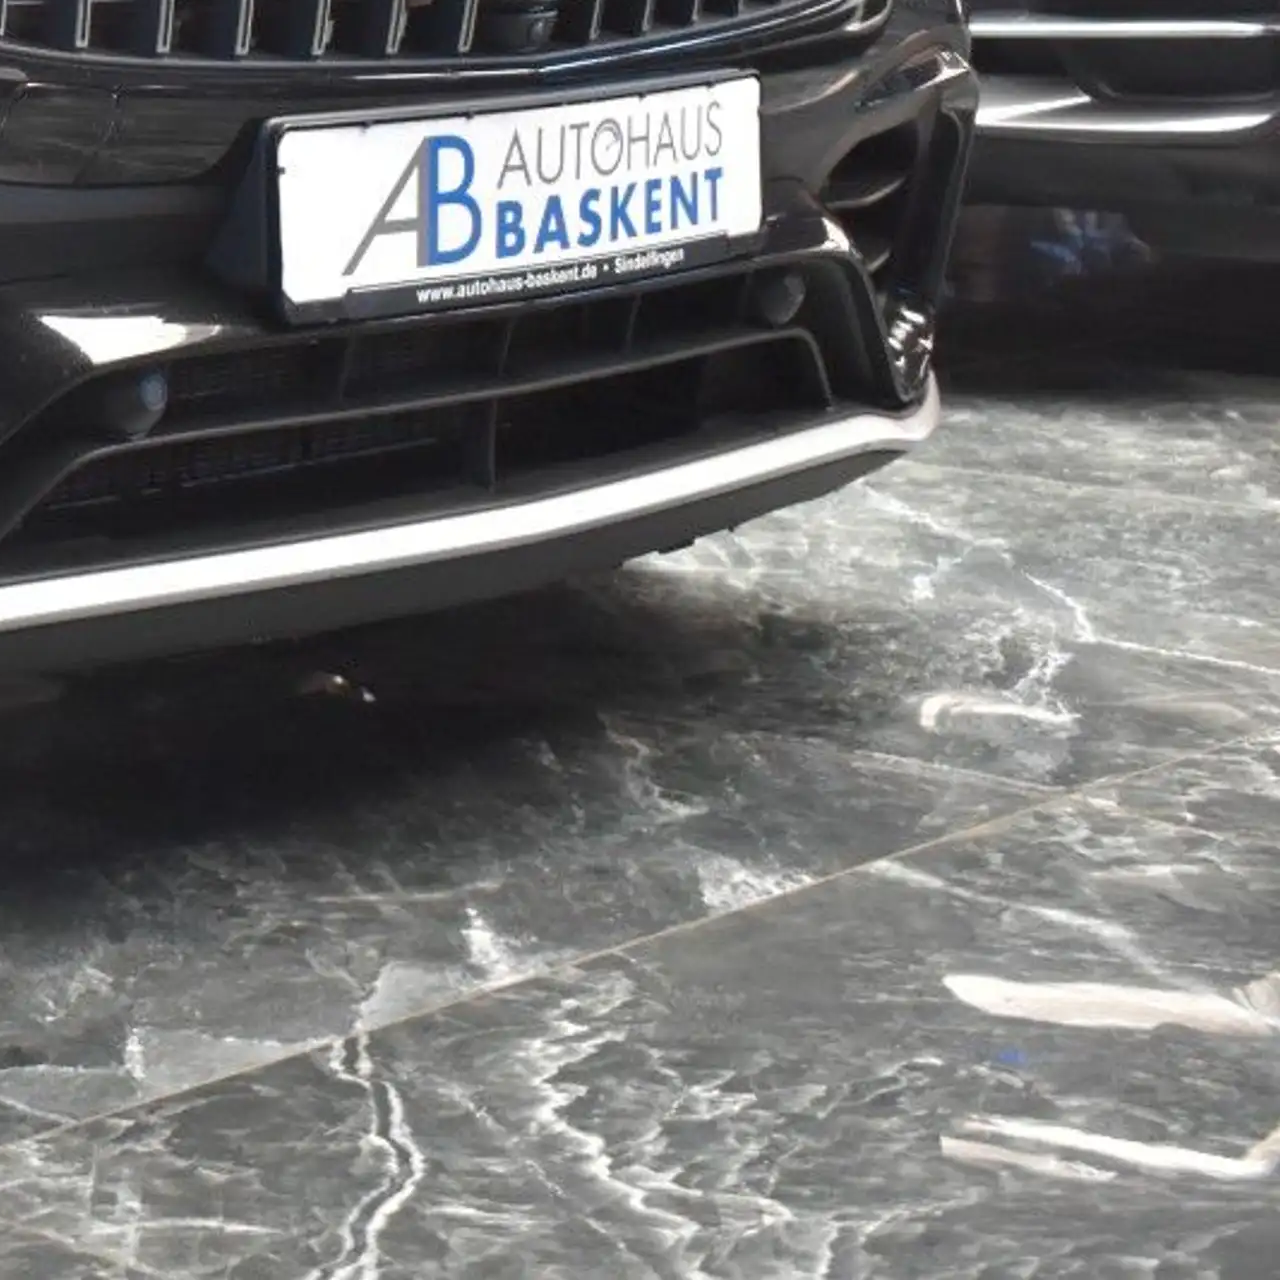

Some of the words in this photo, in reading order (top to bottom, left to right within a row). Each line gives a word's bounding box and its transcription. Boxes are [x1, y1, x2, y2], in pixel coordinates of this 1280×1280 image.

[496, 101, 723, 190] AUTOHAUS
[341, 134, 482, 276] AB
[495, 167, 724, 260] BASKENT
[416, 262, 598, 304] www.autohaus-baskent.de
[614, 248, 685, 274] Sindelfingen
